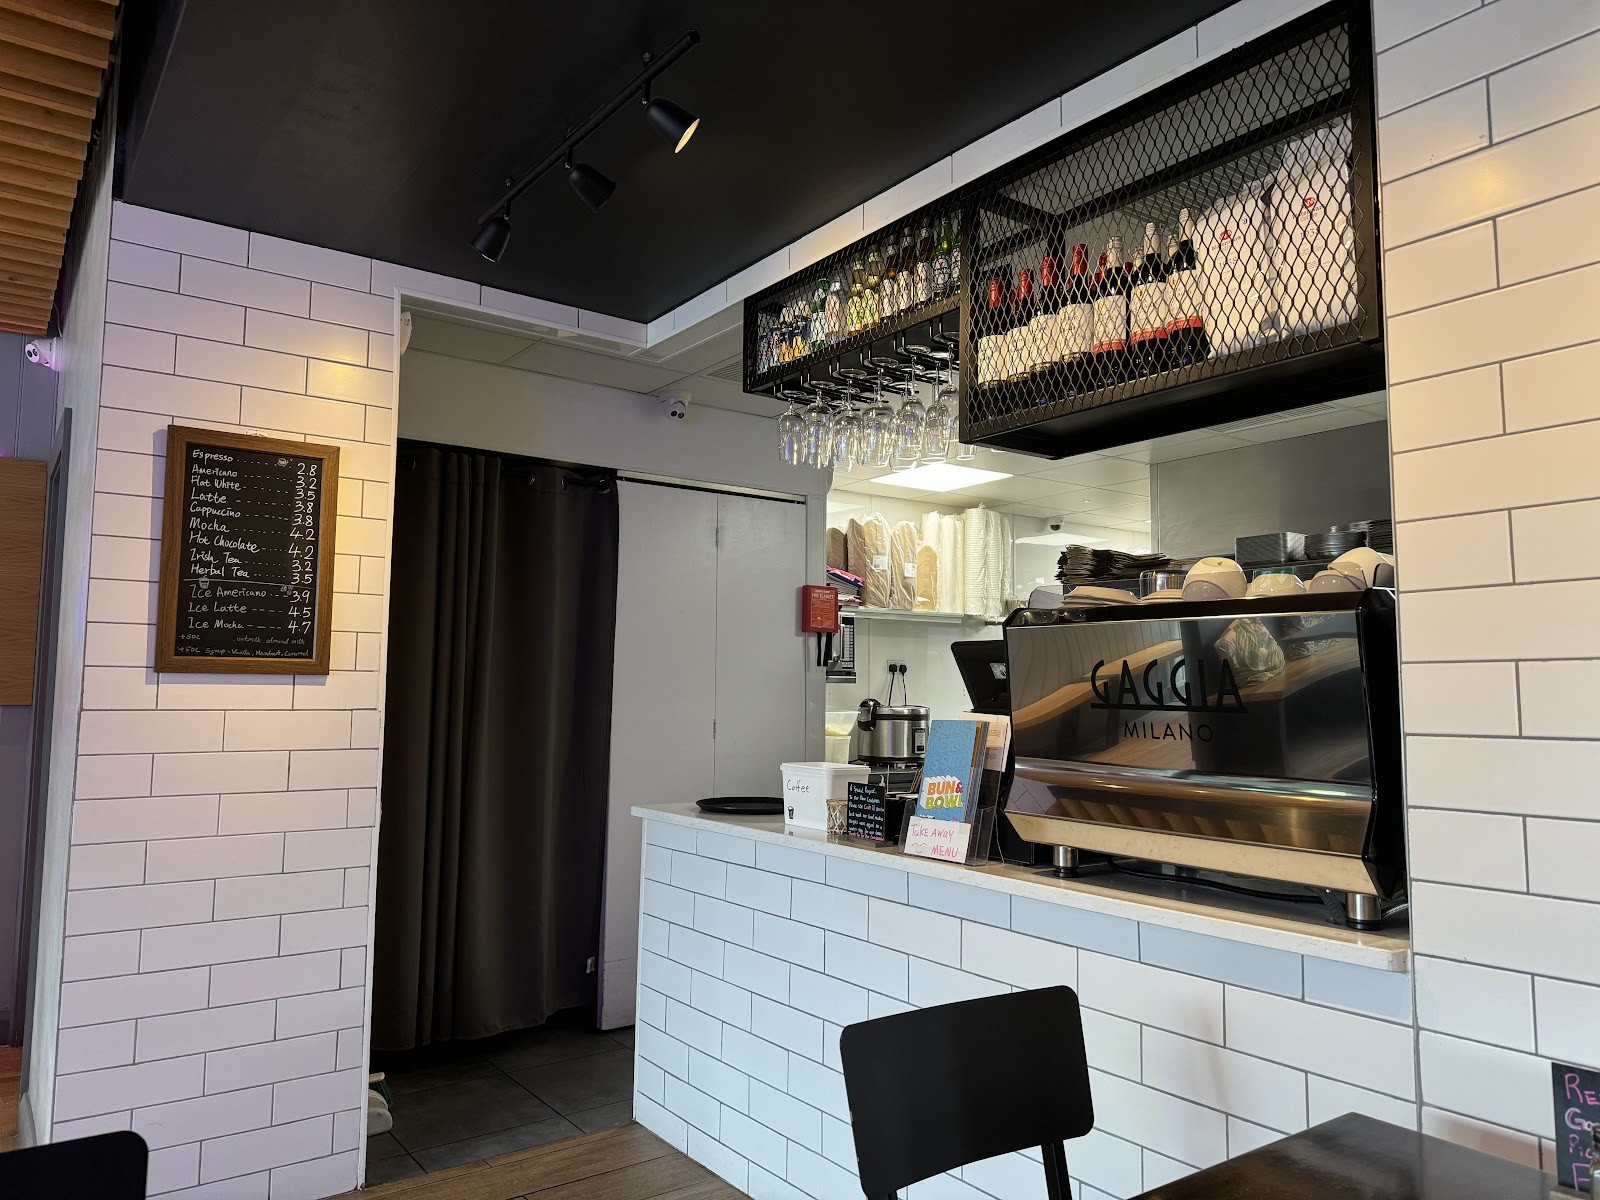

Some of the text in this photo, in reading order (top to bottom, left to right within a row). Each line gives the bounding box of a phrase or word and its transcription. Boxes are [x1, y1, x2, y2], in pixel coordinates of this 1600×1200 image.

[193, 449, 317, 476] Espresso 2.8
[192, 464, 317, 489] Americano 3.2
[191, 475, 315, 501] Flat White 3.5
[191, 488, 314, 514] Latte 3.8
[190, 501, 313, 526] Cappuccino 3.8
[189, 517, 315, 541] Mocha 4.2
[189, 531, 314, 560] Hot Chocolate 4.2
[190, 549, 313, 572] Irish Tea 3.2
[191, 564, 314, 584] Herbal Tea 3.5
[189, 584, 310, 603] Ice Americano 3.9
[188, 602, 311, 618] Ice Latte 4.5
[188, 617, 311, 634] Ice Mocha 4.7
[1091, 659, 1244, 707] GAGGIA
[1124, 721, 1213, 742] MILANO
[786, 779, 810, 794] Coffee
[928, 781, 963, 795] BUN &
[925, 794, 963, 809] BOWL
[931, 846, 958, 858] MENU
